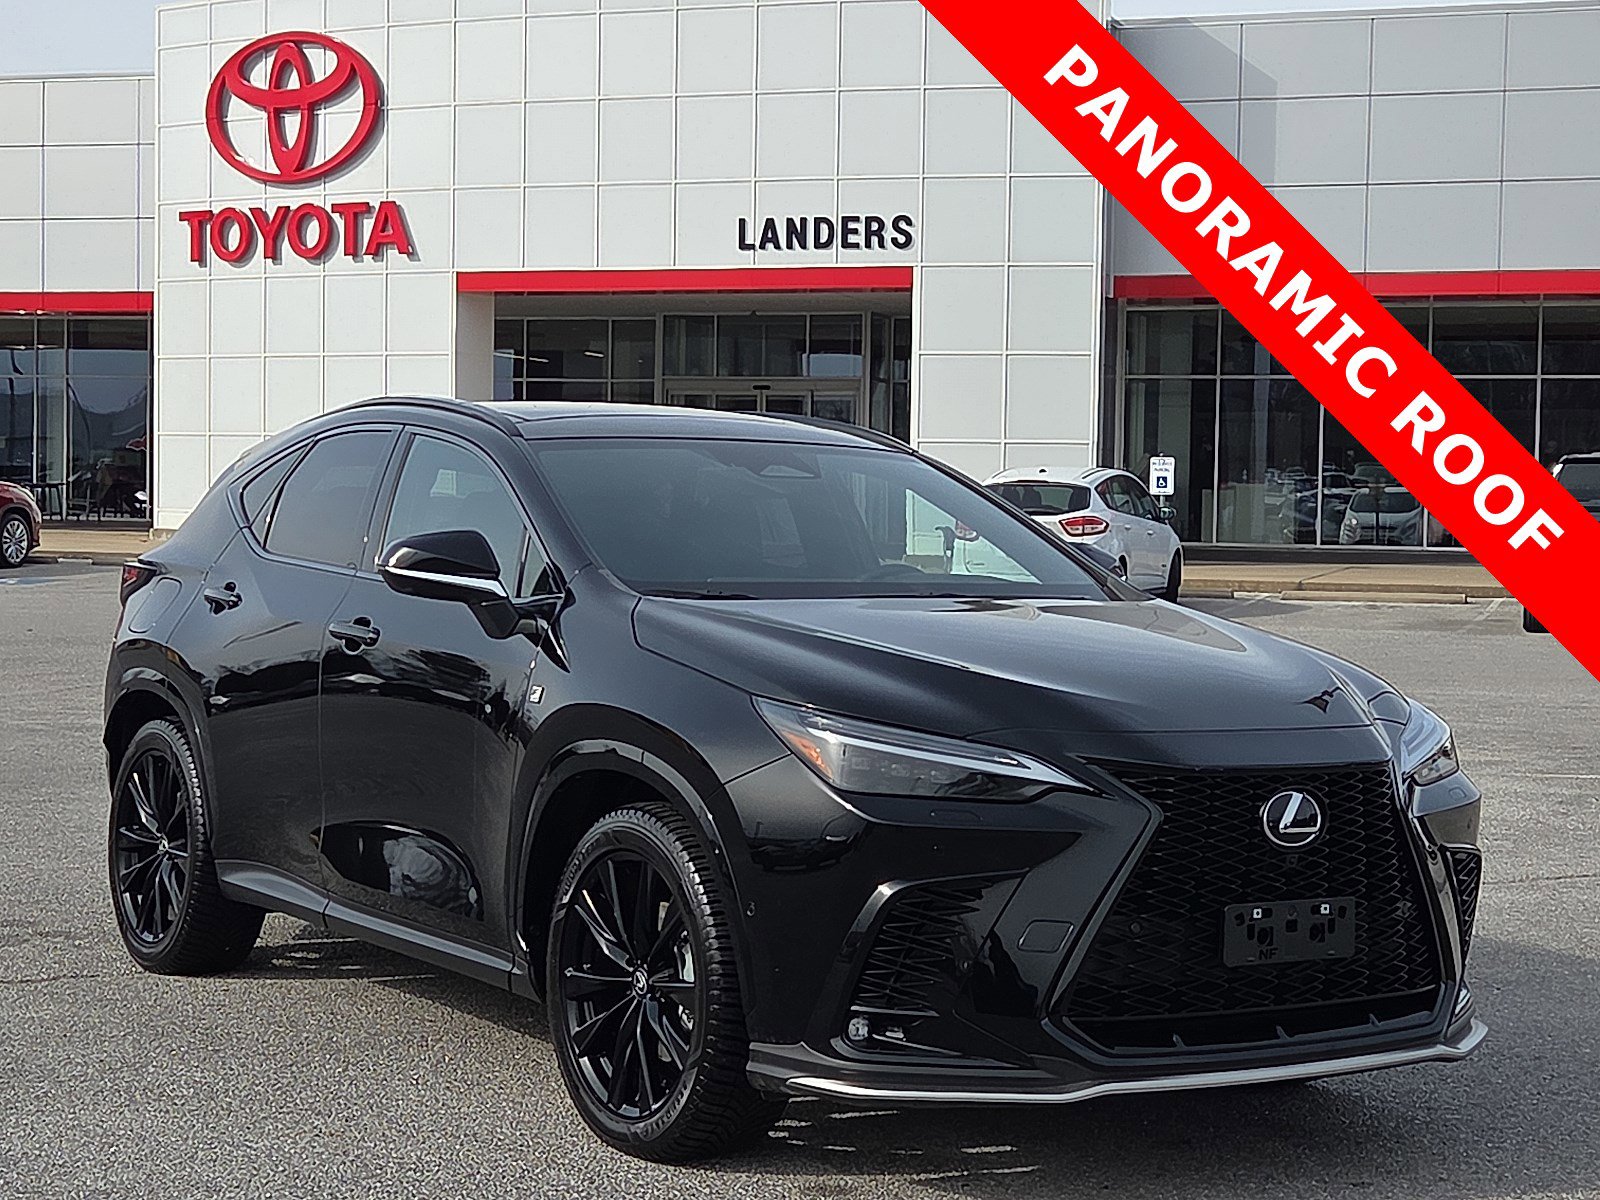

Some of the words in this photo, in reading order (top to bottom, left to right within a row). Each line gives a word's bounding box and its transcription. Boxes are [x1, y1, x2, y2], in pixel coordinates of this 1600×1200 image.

[179, 201, 411, 262] TOYOTA
[738, 214, 913, 252] LANDERS
[1258, 947, 1279, 961] NF
